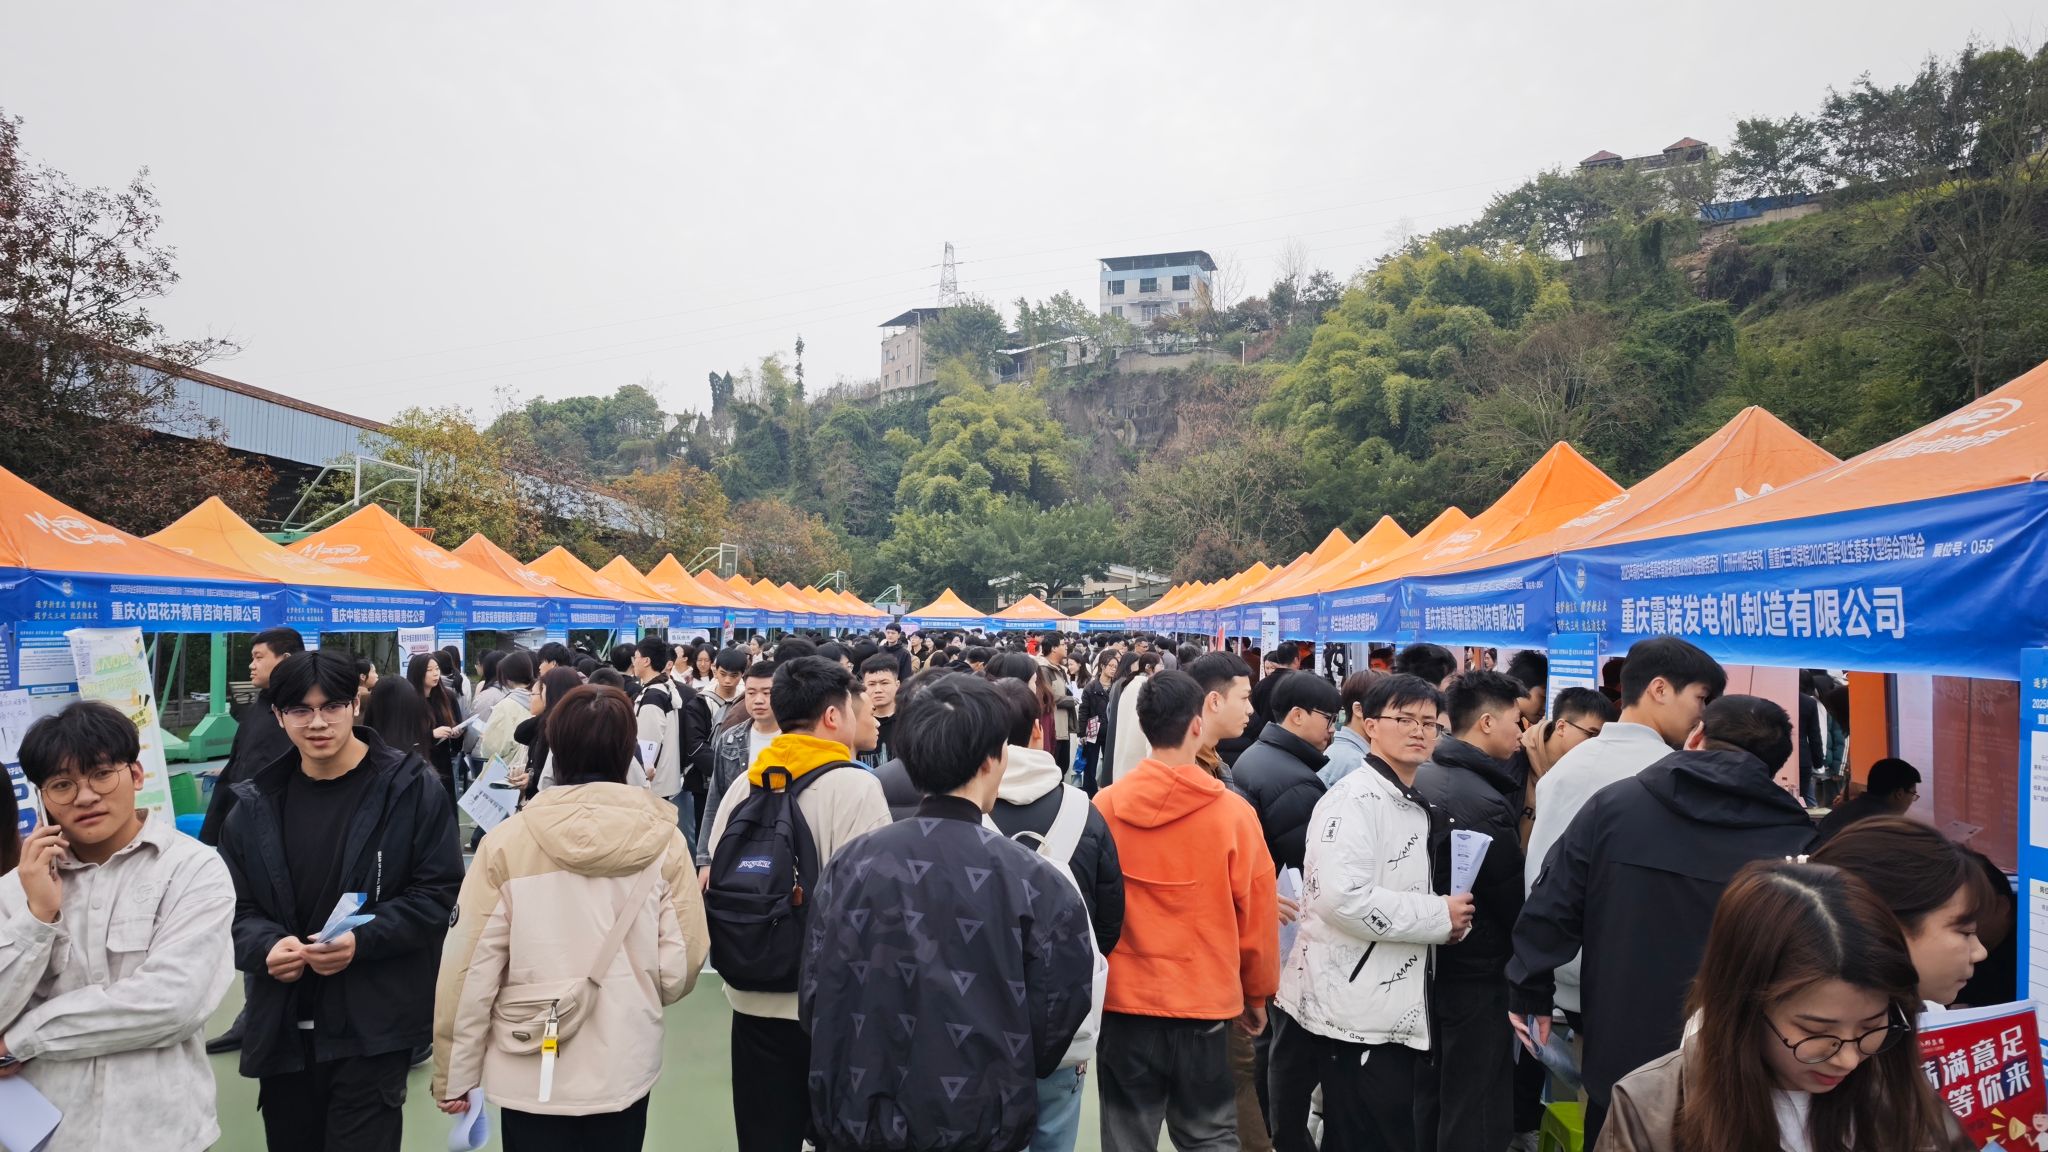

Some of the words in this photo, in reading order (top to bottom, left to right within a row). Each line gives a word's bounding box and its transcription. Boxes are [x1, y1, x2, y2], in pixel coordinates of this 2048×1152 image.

[111, 601, 261, 622] 重庆心田花开教育咨询有限公司
[331, 608, 425, 624] 重庆中能诺德商贸有限责任公司
[1620, 586, 1905, 639] 重庆霞诺发电机制造有限公司
[1947, 1060, 2031, 1118] 等你来
